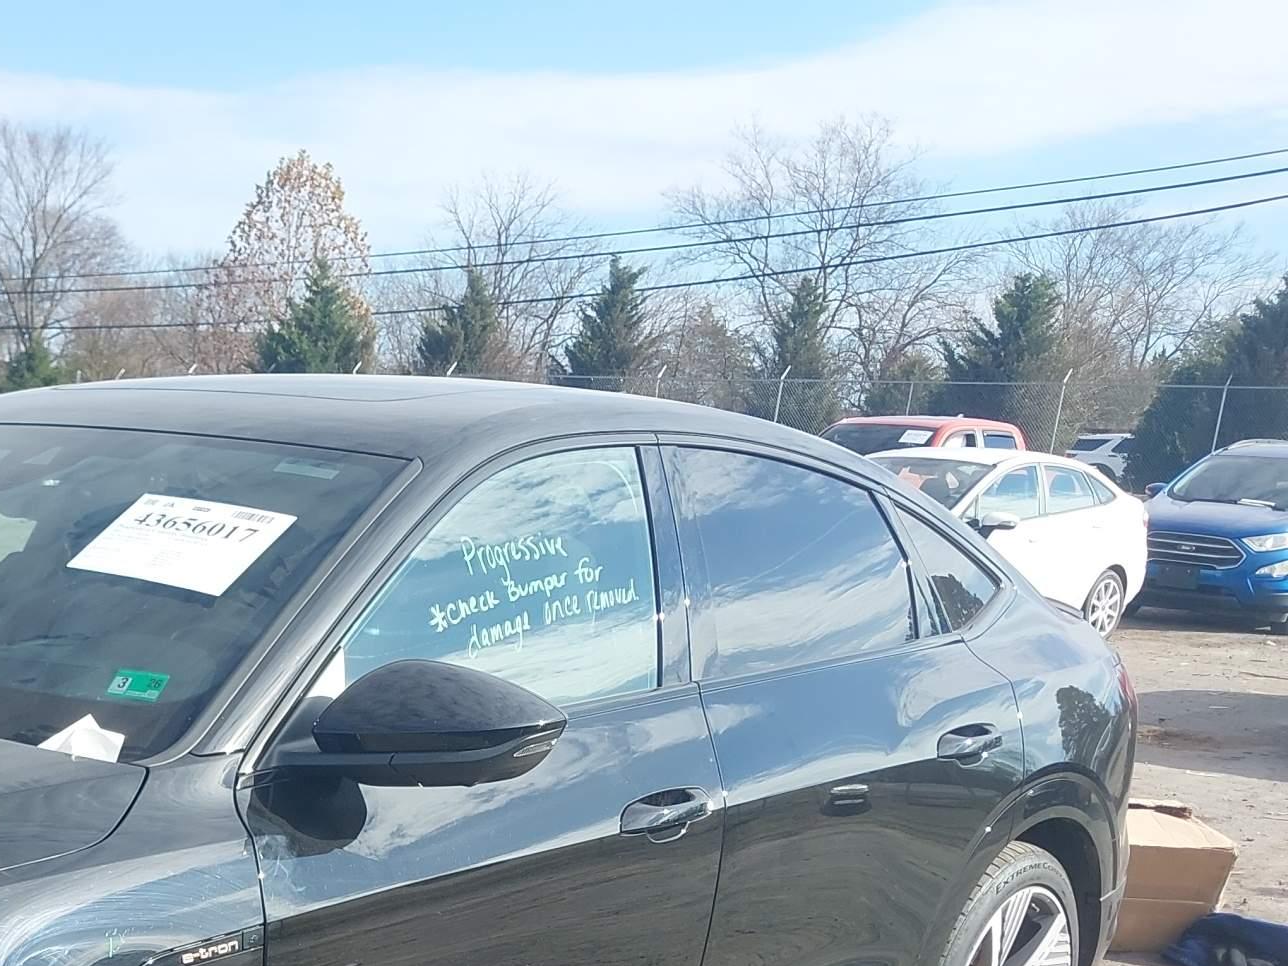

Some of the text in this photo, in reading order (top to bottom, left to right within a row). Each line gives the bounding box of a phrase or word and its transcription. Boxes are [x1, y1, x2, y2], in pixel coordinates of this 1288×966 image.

[134, 512, 260, 543] 43656017
[461, 532, 569, 587] Progressive
[574, 557, 604, 584] for
[468, 610, 531, 659] damage
[116, 677, 130, 689] 3
[181, 940, 239, 965] e-tron
